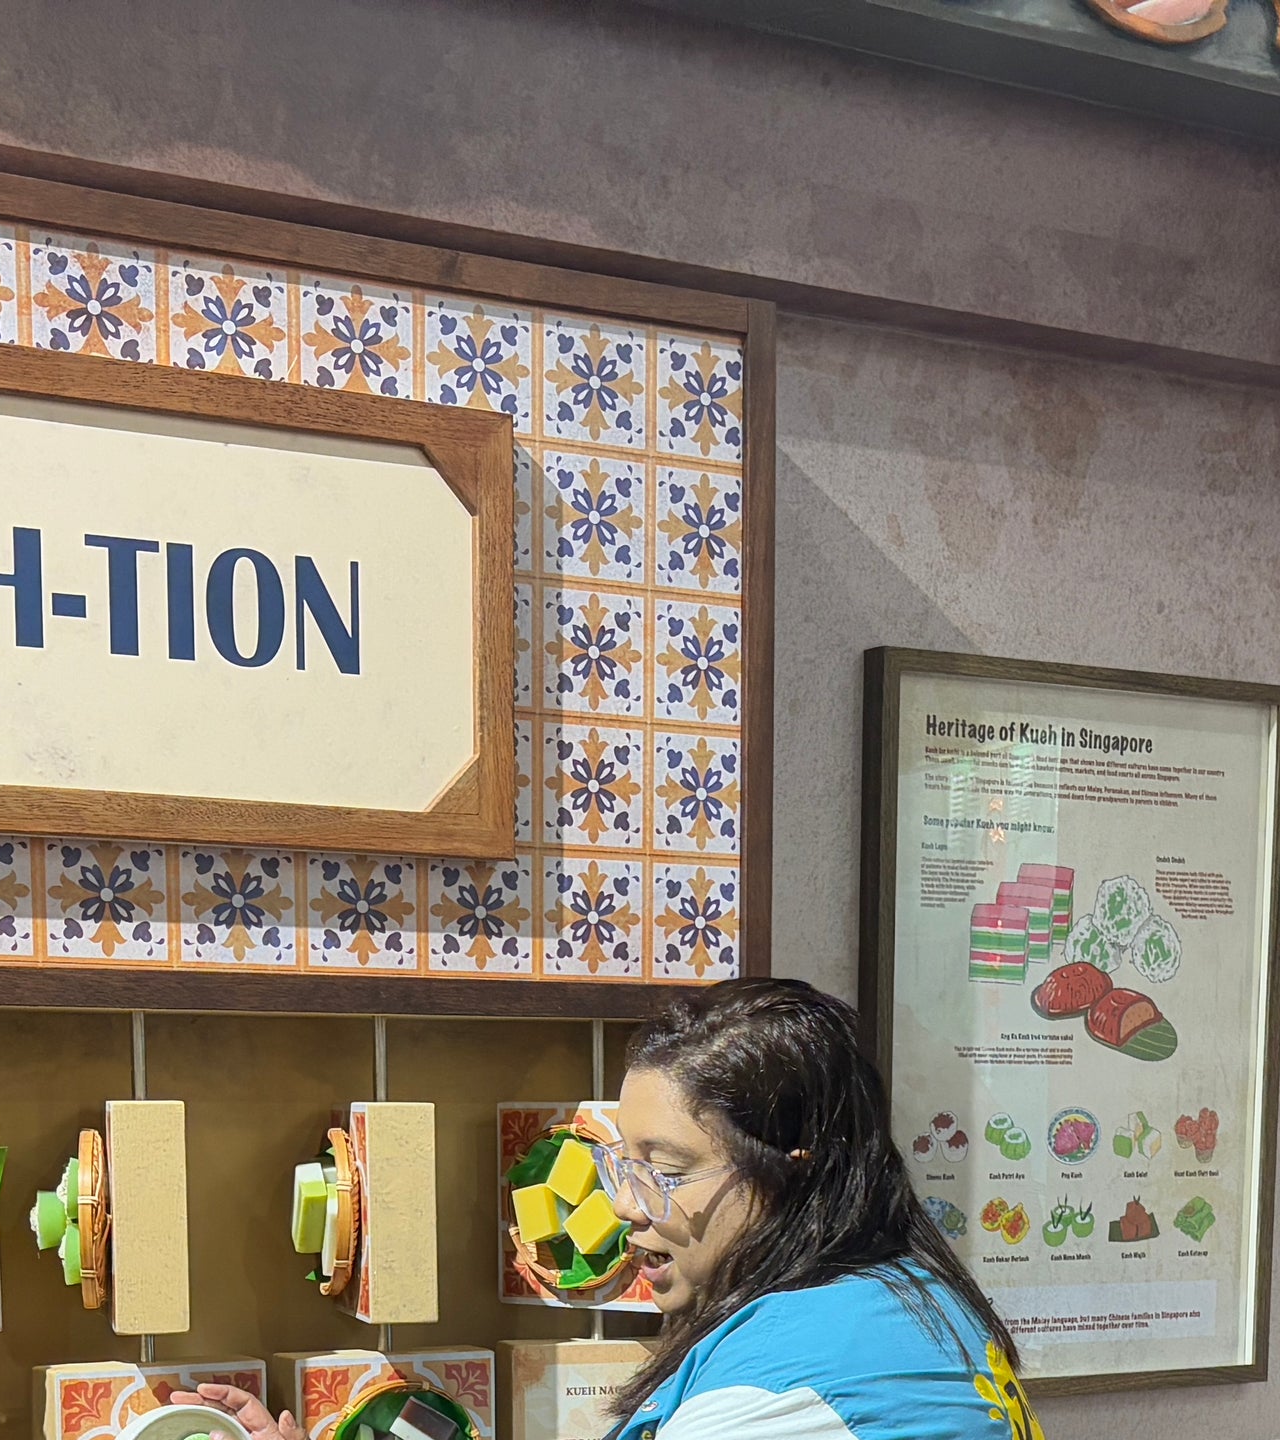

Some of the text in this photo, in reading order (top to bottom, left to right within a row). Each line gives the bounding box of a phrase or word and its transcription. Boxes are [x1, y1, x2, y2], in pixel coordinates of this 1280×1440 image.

[925, 714, 1153, 756] Heritage of Kueh in Singapore
[923, 815, 944, 826] Some
[975, 818, 994, 830] Kueh
[996, 821, 1009, 831] you
[1010, 821, 1032, 833] might
[1005, 1317, 1019, 1326] from
[1020, 1317, 1030, 1325] the
[1031, 1316, 1050, 1325] Malay
[1090, 1315, 1107, 1323] many
[1108, 1313, 1130, 1321] Chinese
[1131, 1312, 1154, 1320] families
[1161, 1311, 1188, 1320] Singapore
[1010, 1326, 1036, 1334] different
[1037, 1325, 1062, 1333] cultures
[1096, 1322, 1120, 1331] together
[1121, 1321, 1134, 1329] over
[566, 1387, 596, 1396] KUEH
